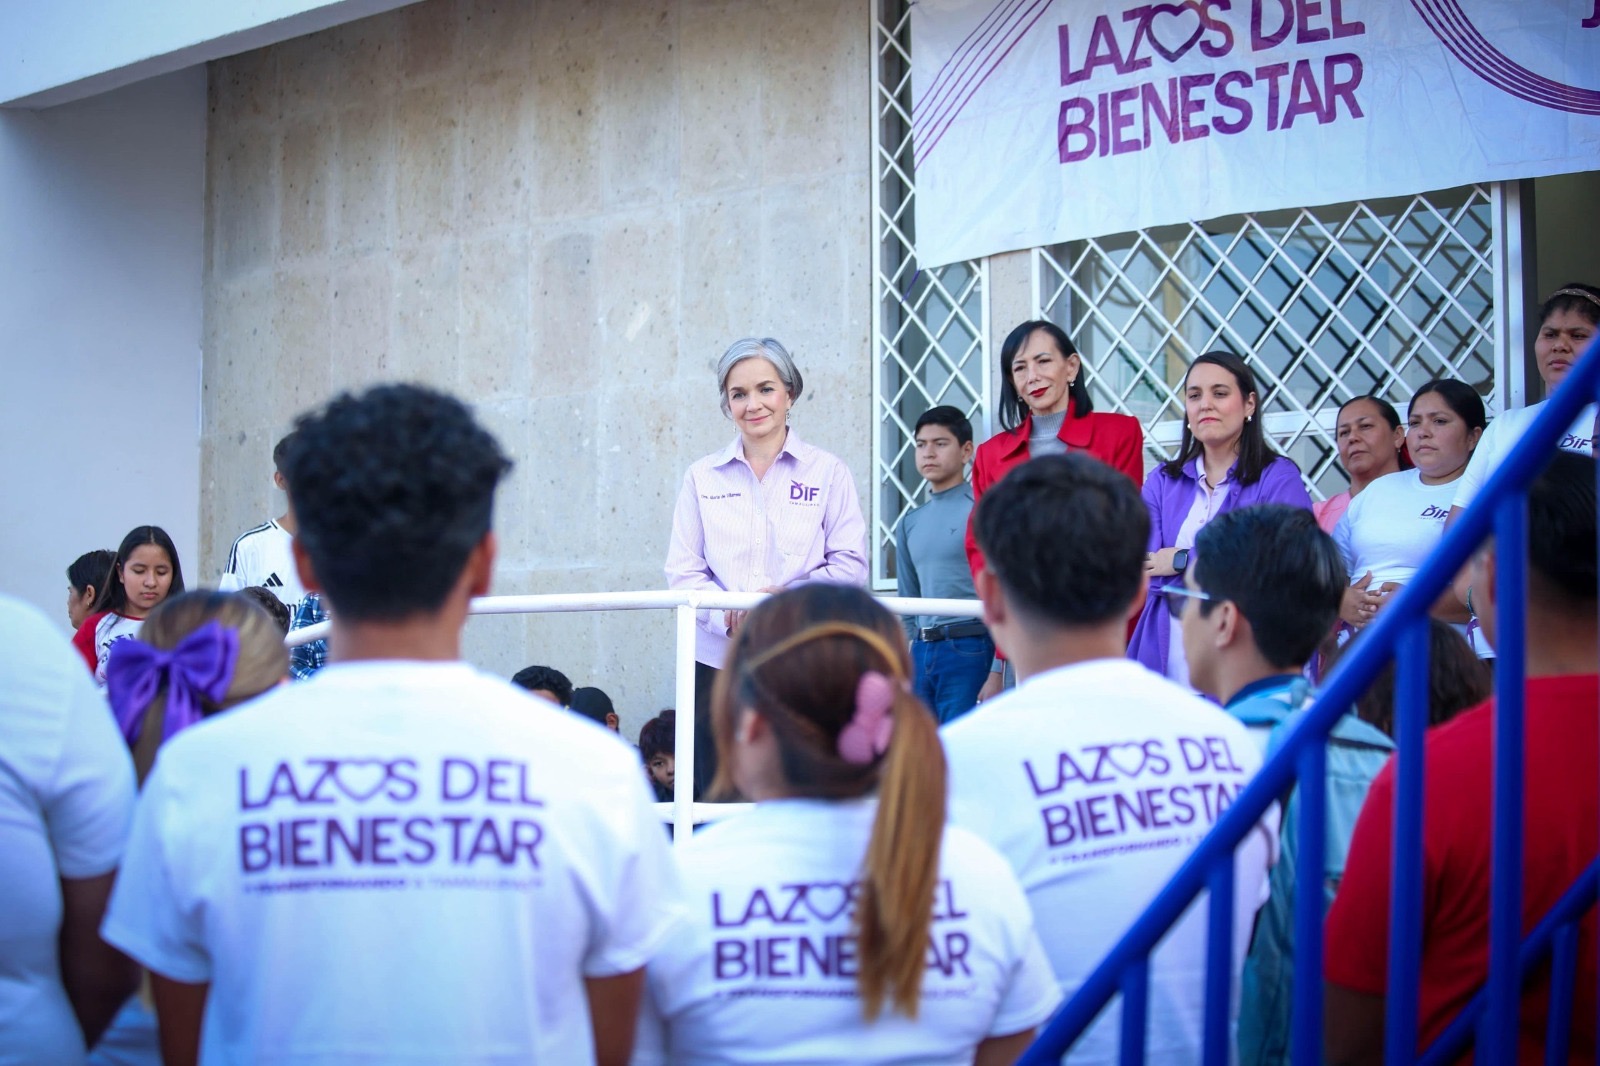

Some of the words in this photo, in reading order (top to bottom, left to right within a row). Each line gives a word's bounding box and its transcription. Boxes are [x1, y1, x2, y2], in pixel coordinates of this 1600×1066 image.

[1251, 0, 1366, 52] DEL
[1058, 52, 1365, 164] BIENESTAR
[790, 483, 820, 501] DIF
[1178, 737, 1244, 773] DEL
[441, 758, 545, 807] DEL
[240, 816, 544, 873] BIENESTAR
